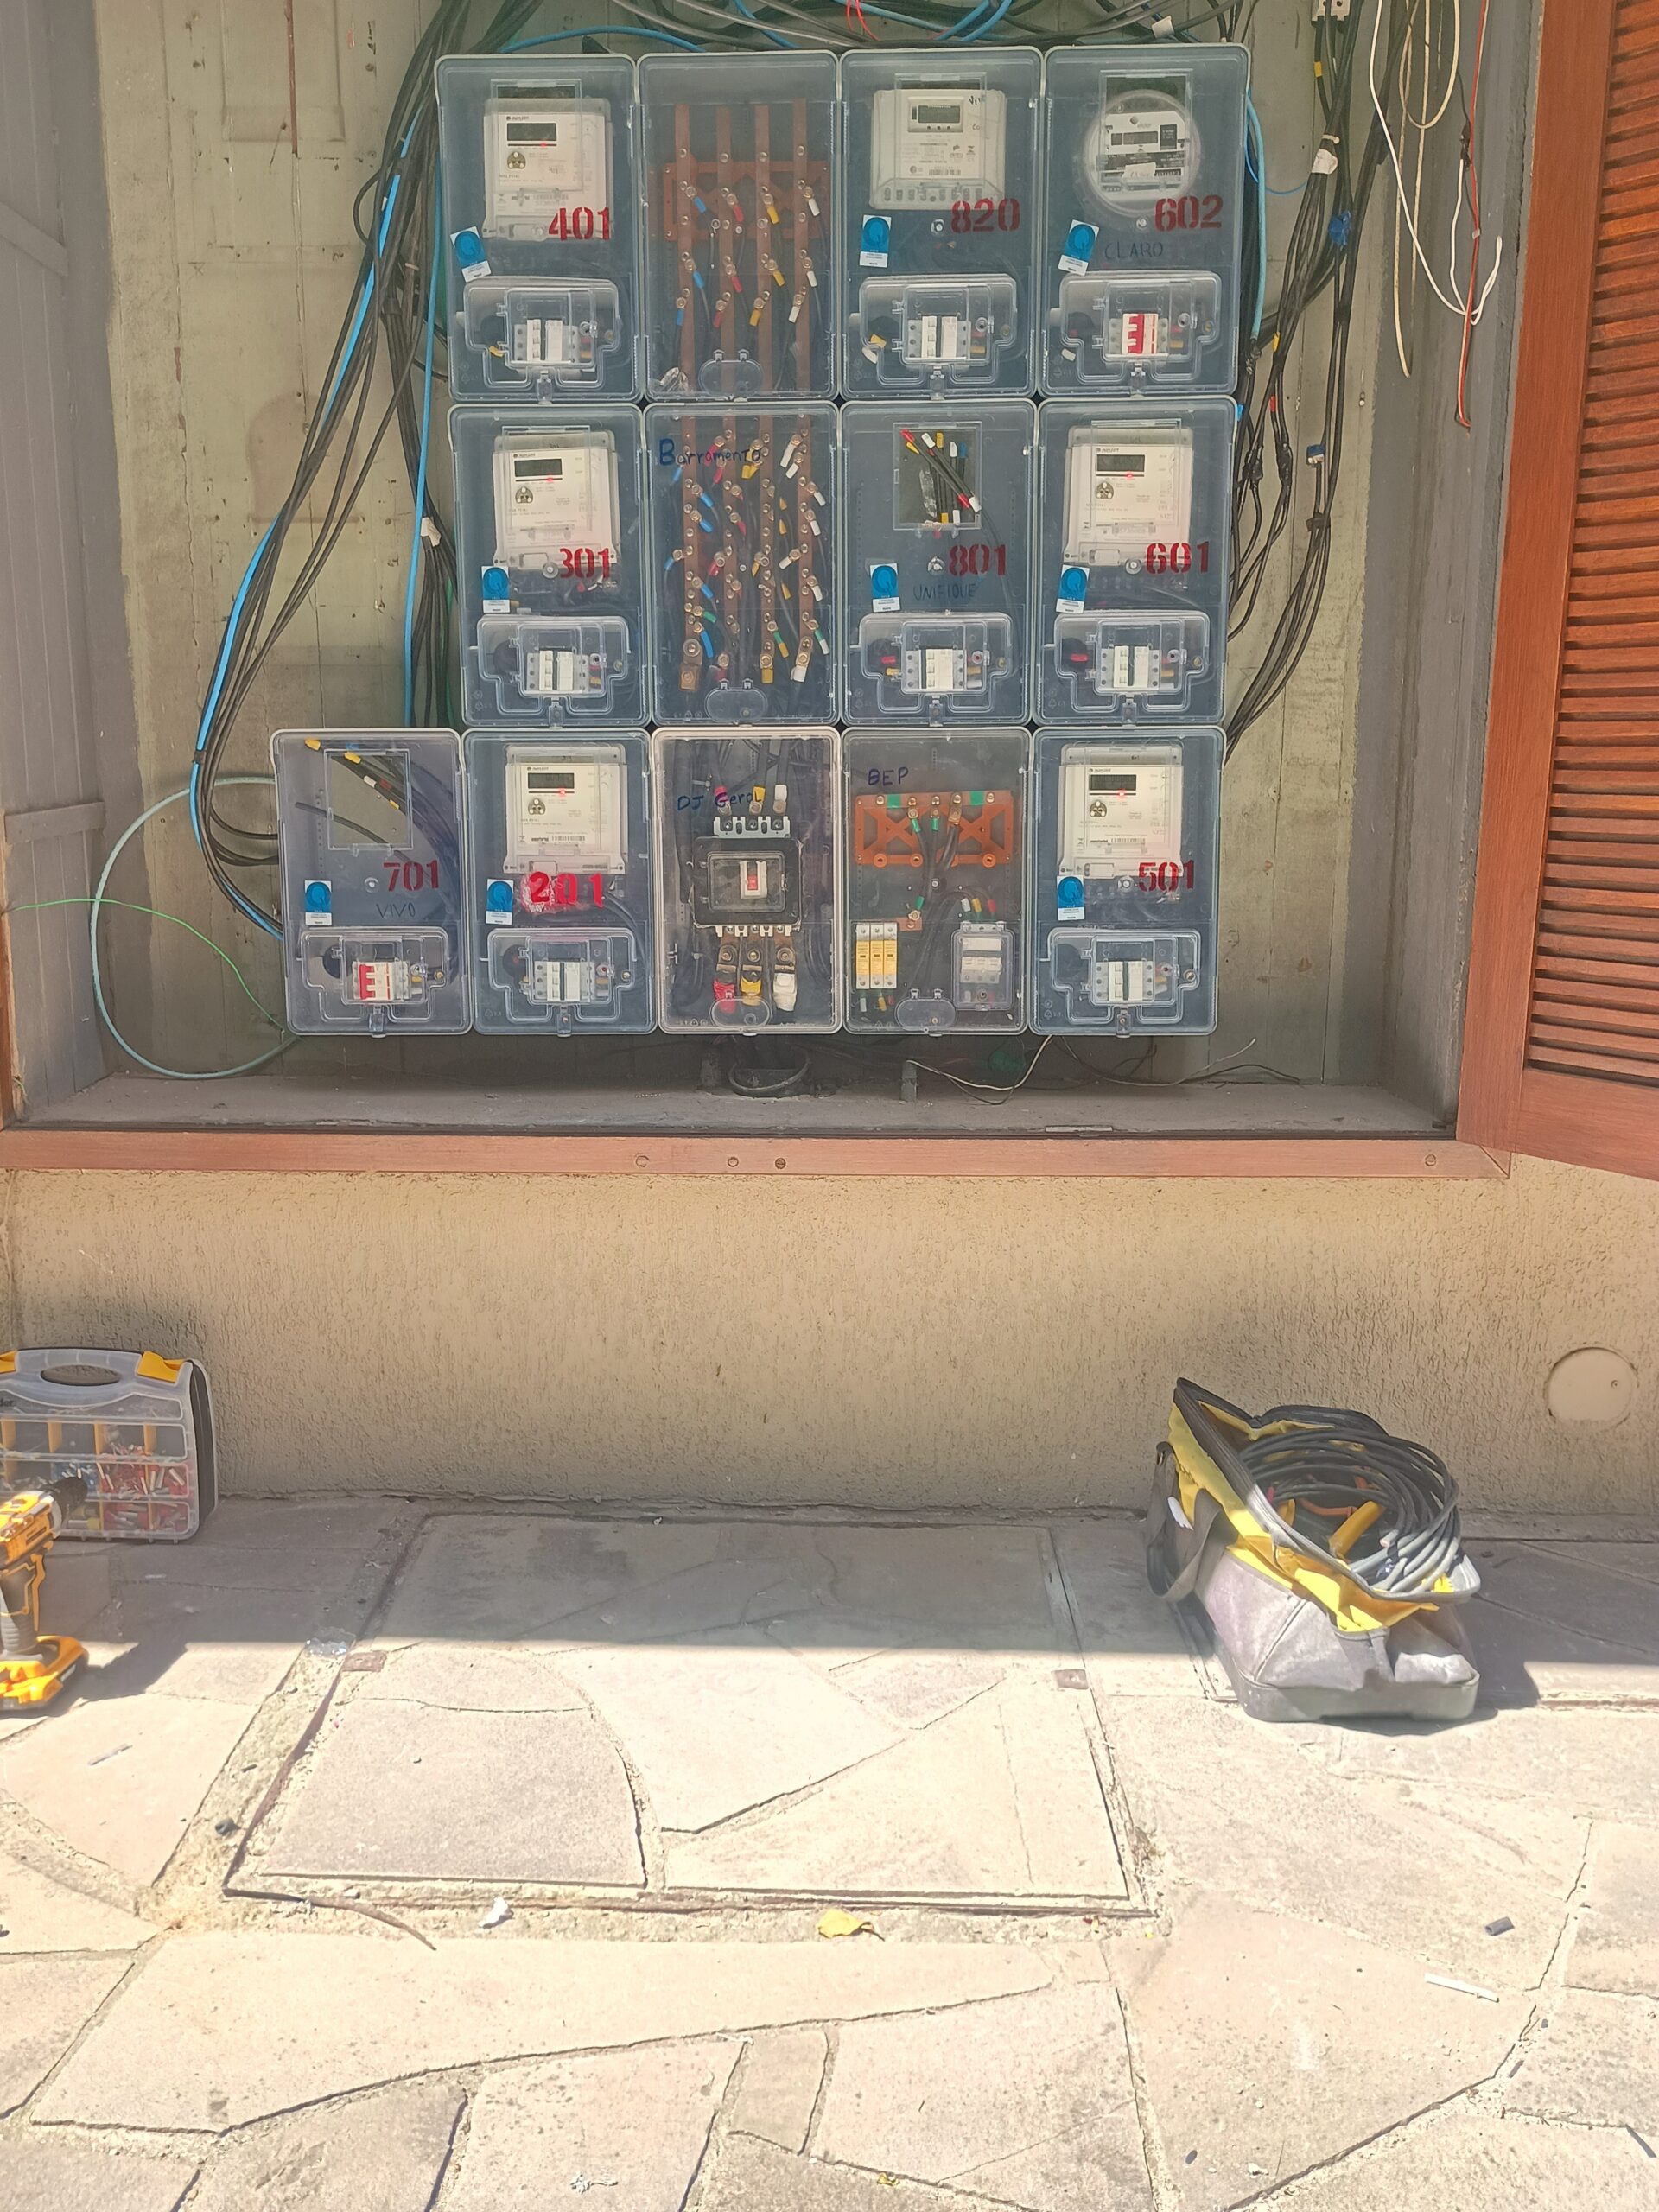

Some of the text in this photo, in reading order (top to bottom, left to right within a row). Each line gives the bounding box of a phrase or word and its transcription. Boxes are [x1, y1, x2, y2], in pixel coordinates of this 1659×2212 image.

[548, 207, 610, 240] 401
[950, 198, 1020, 233] 820
[1154, 194, 1223, 232] 602
[1104, 241, 1164, 259] CLARO
[559, 547, 611, 579] 301
[949, 543, 1007, 576] 801
[1146, 541, 1210, 575] 601
[868, 766, 909, 785] BEP
[677, 795, 704, 810] DJ
[383, 859, 440, 892] 701
[529, 871, 604, 907] 201
[1138, 859, 1195, 893] 501
[375, 902, 416, 918] VIVO
